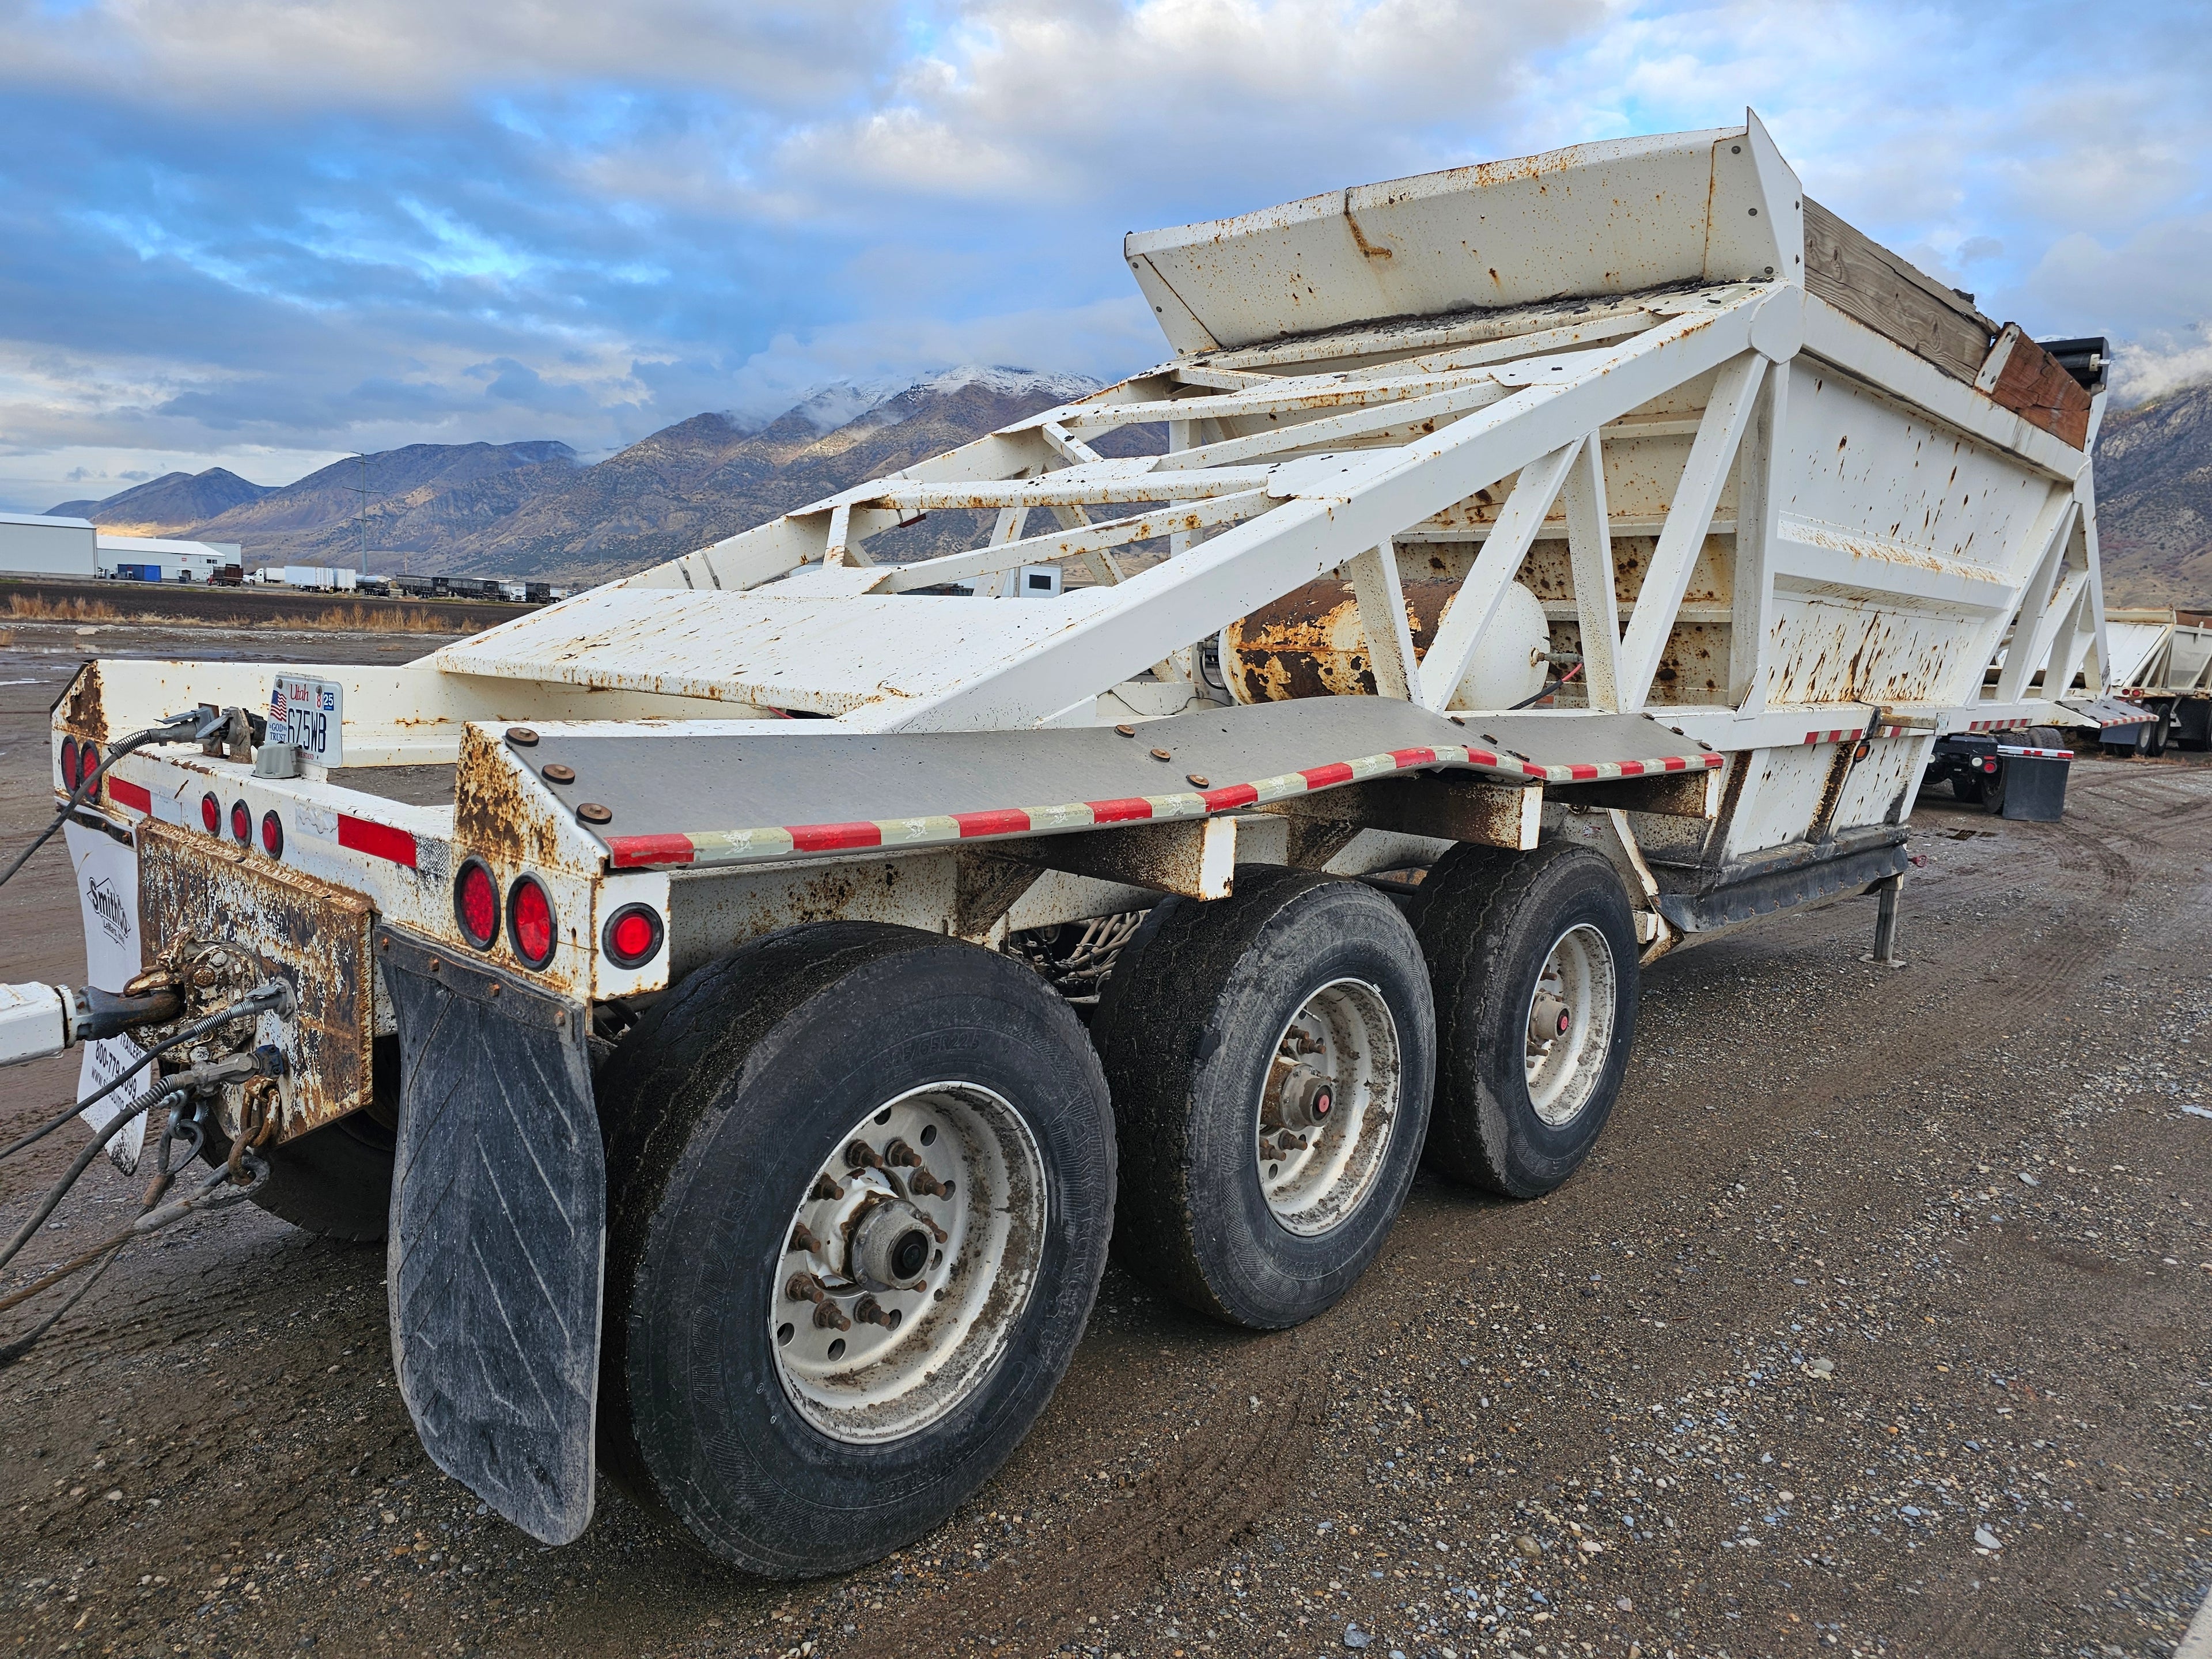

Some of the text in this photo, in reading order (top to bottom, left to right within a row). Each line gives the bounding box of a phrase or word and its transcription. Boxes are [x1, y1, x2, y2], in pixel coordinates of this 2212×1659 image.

[290, 684, 309, 702] Utah
[324, 694, 334, 706] 25
[317, 694, 321, 708] 8
[271, 723, 283, 732] GOD
[288, 708, 327, 753] 675WB
[270, 732, 286, 742] TRUST
[303, 752, 314, 760] STAND
[89, 877, 128, 938] SmithCo
[120, 1033, 142, 1061] TRAILERS
